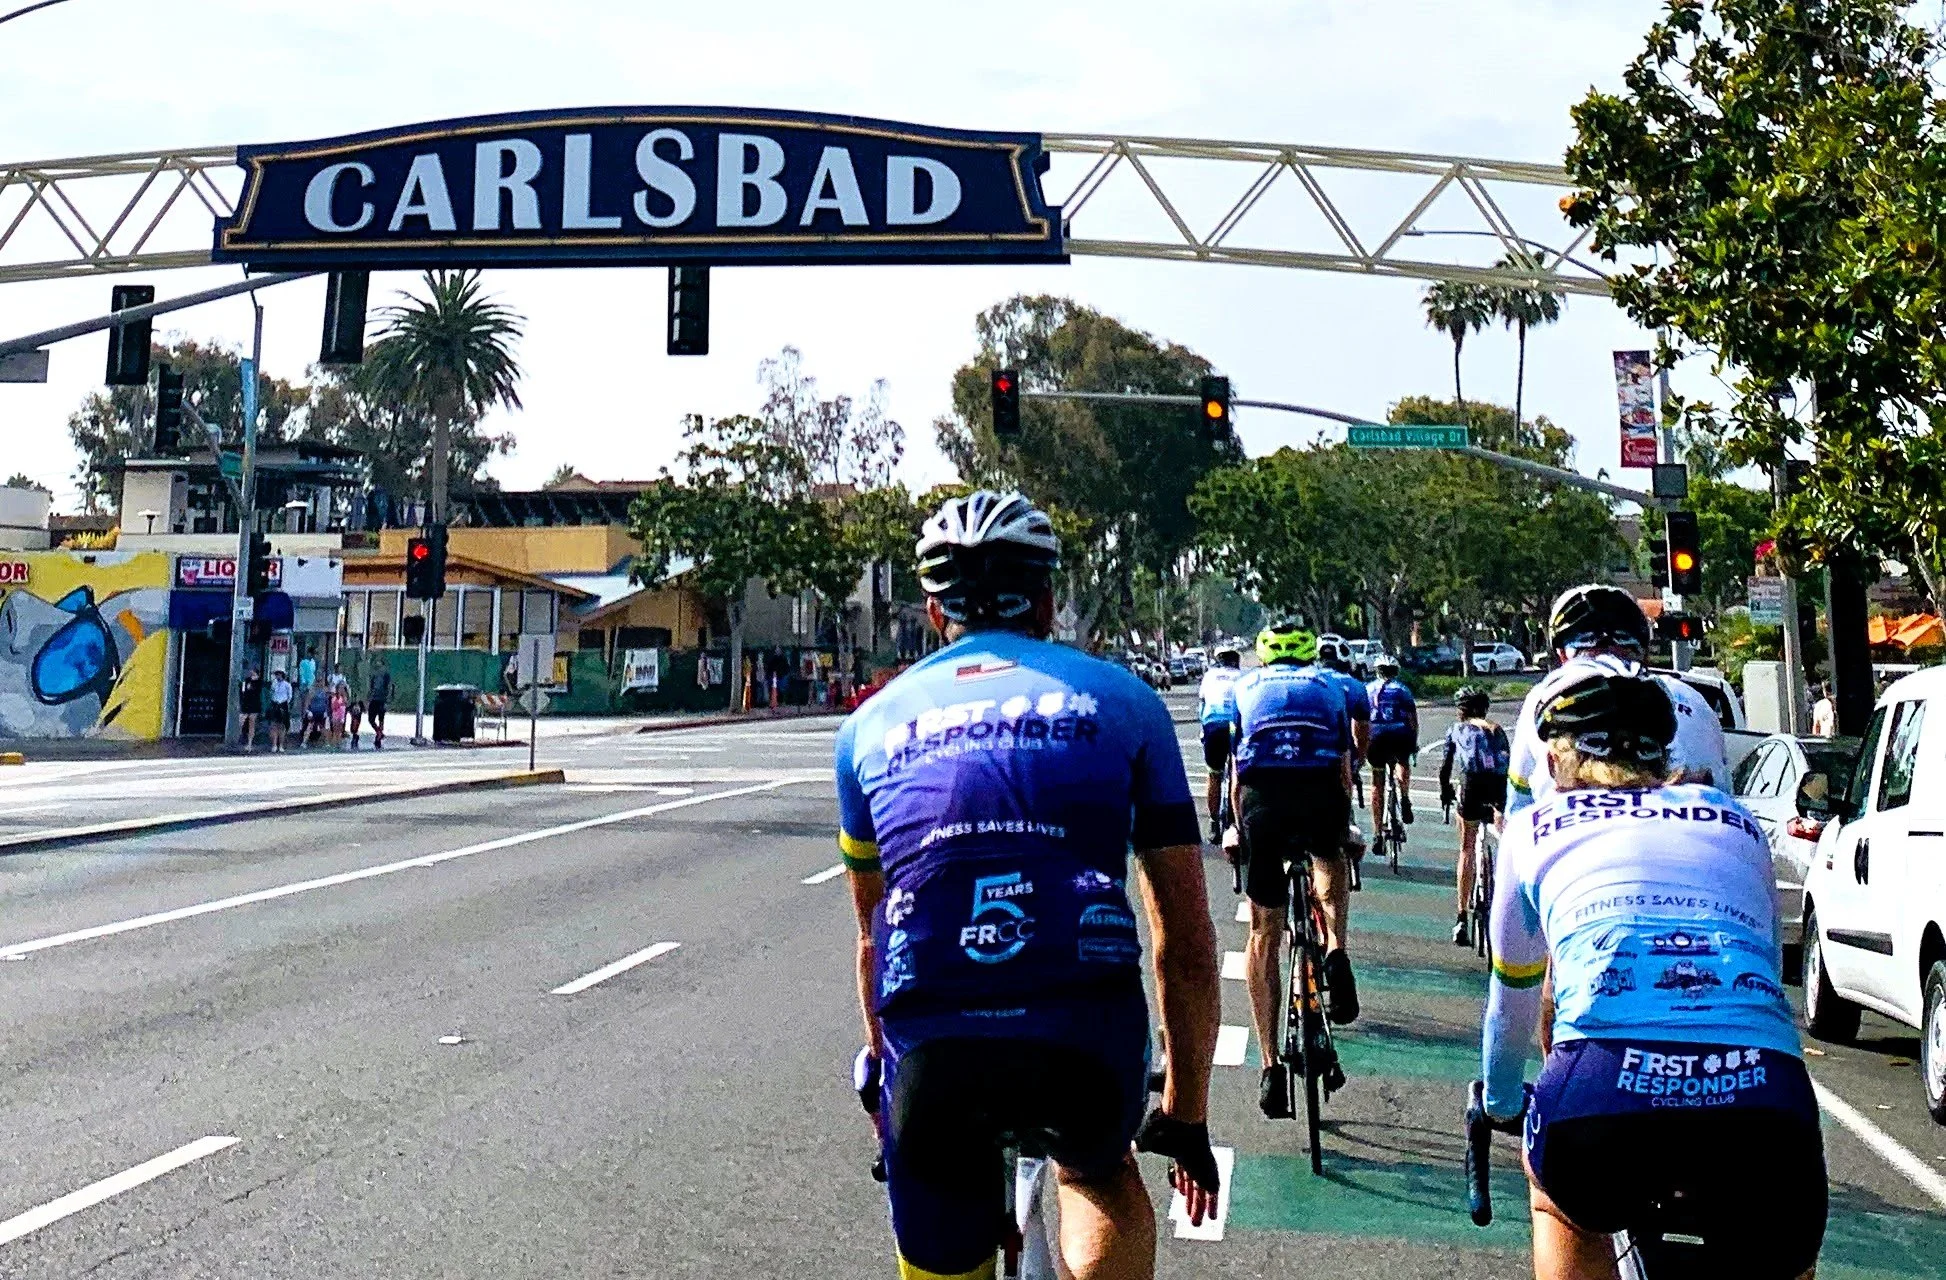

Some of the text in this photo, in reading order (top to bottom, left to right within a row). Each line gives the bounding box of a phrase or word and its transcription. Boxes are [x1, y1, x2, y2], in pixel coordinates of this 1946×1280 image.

[304, 128, 962, 232] CARLSBAD
[1352, 430, 1461, 447] Carlsbad Village Dr
[977, 819, 1024, 833] SAVES
[1027, 821, 1065, 838] LIVES
[1533, 807, 1759, 846] RESPONDER
[986, 881, 1034, 899] YEARS
[1575, 895, 1646, 922] FITNESS
[1650, 894, 1708, 909] SAVES
[959, 918, 1035, 947] FRCC
[1622, 1047, 1699, 1077] FIRST
[1617, 1066, 1767, 1096] RESPONDER
[1651, 1093, 1735, 1107] CYCLING CLUB
